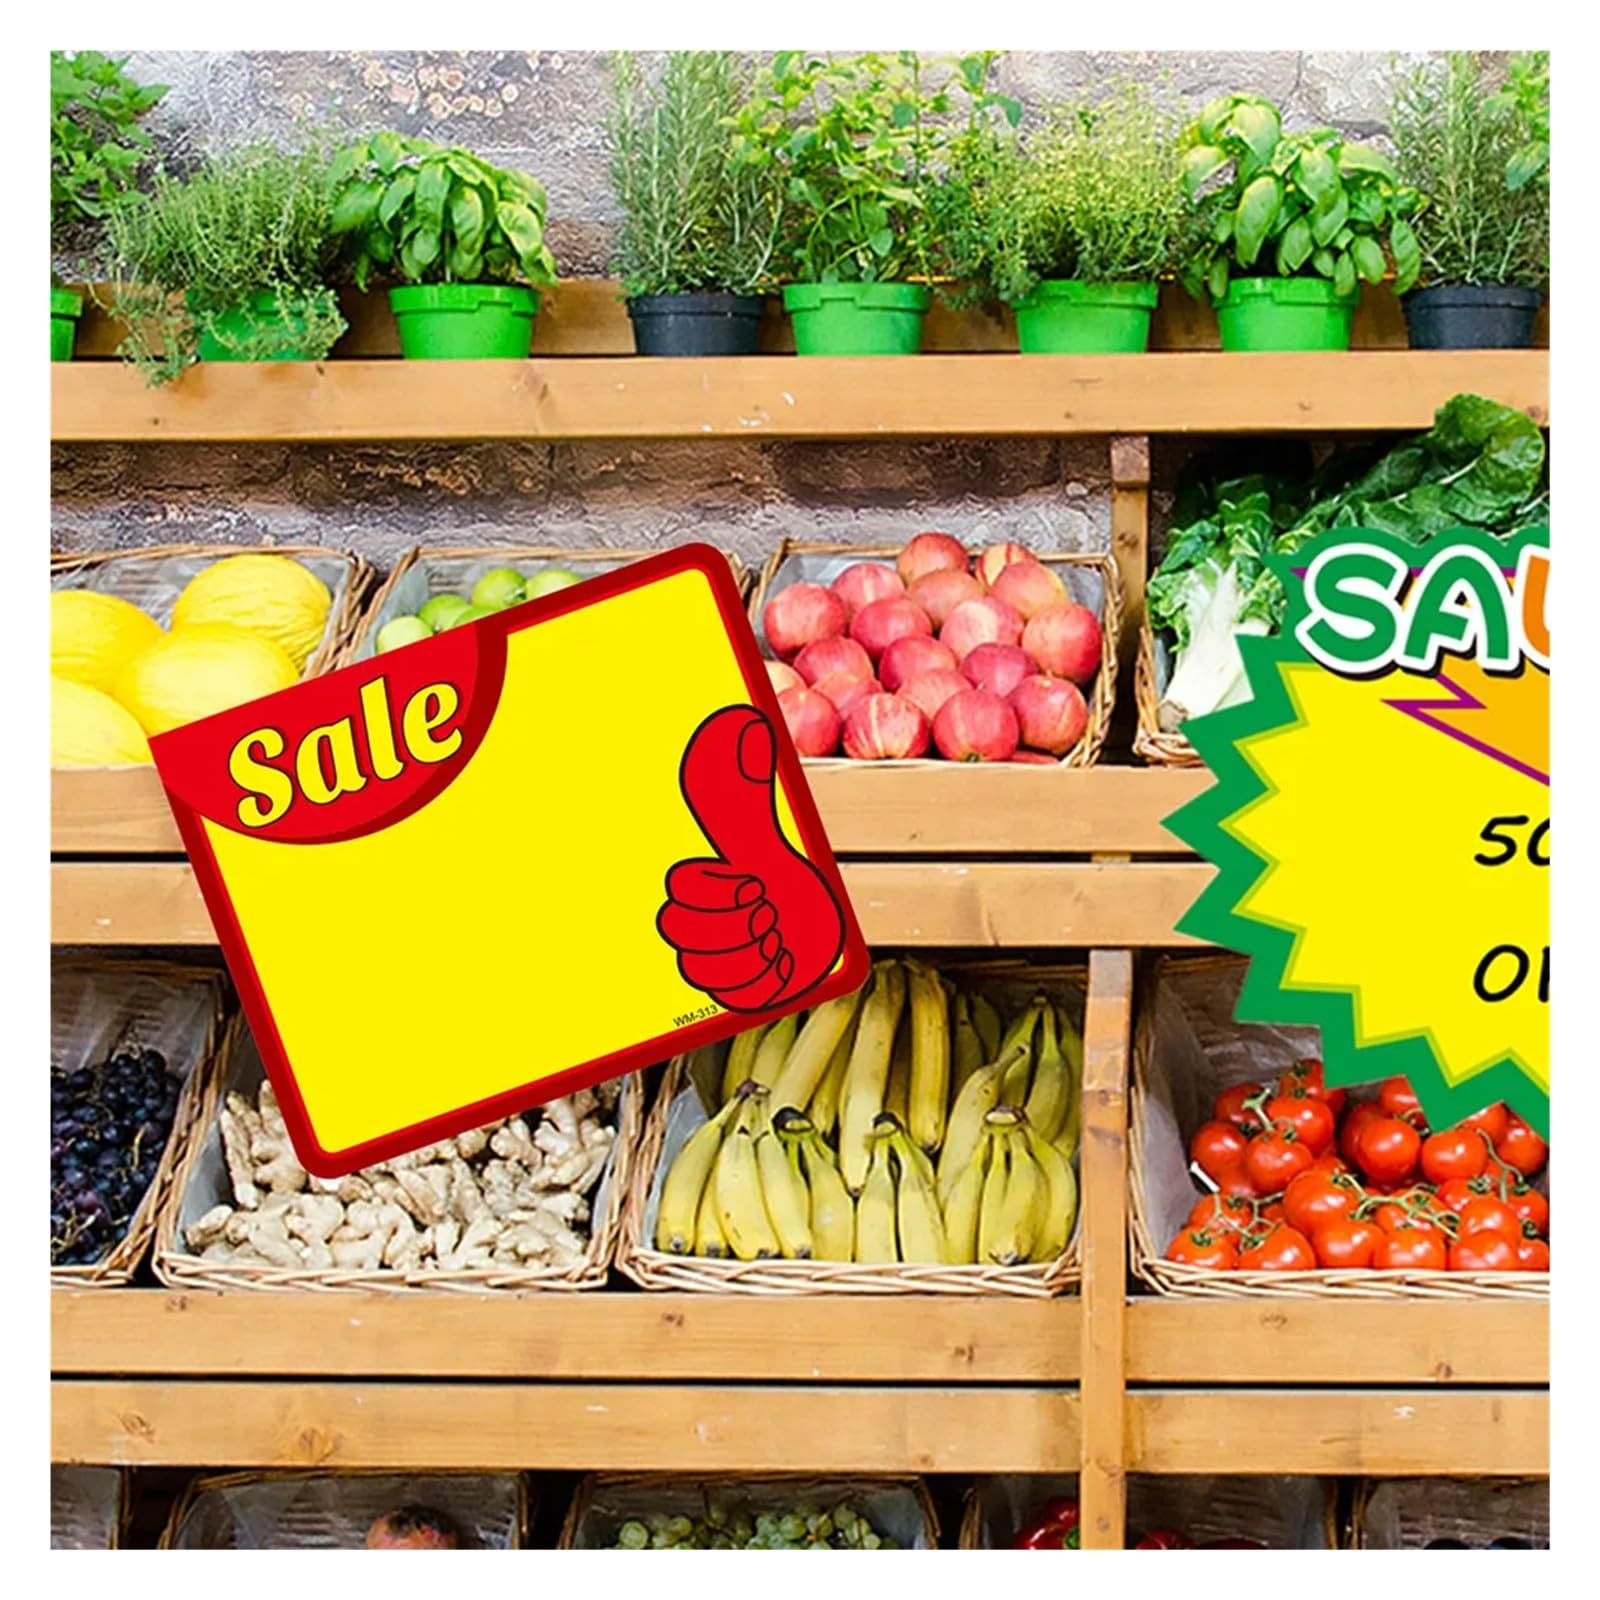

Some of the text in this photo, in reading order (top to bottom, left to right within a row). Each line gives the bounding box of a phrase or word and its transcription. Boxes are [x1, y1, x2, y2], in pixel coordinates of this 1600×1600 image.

[227, 675, 463, 829] Sale
[1472, 943, 1550, 1004] O
[672, 1003, 719, 1028] WM-313
